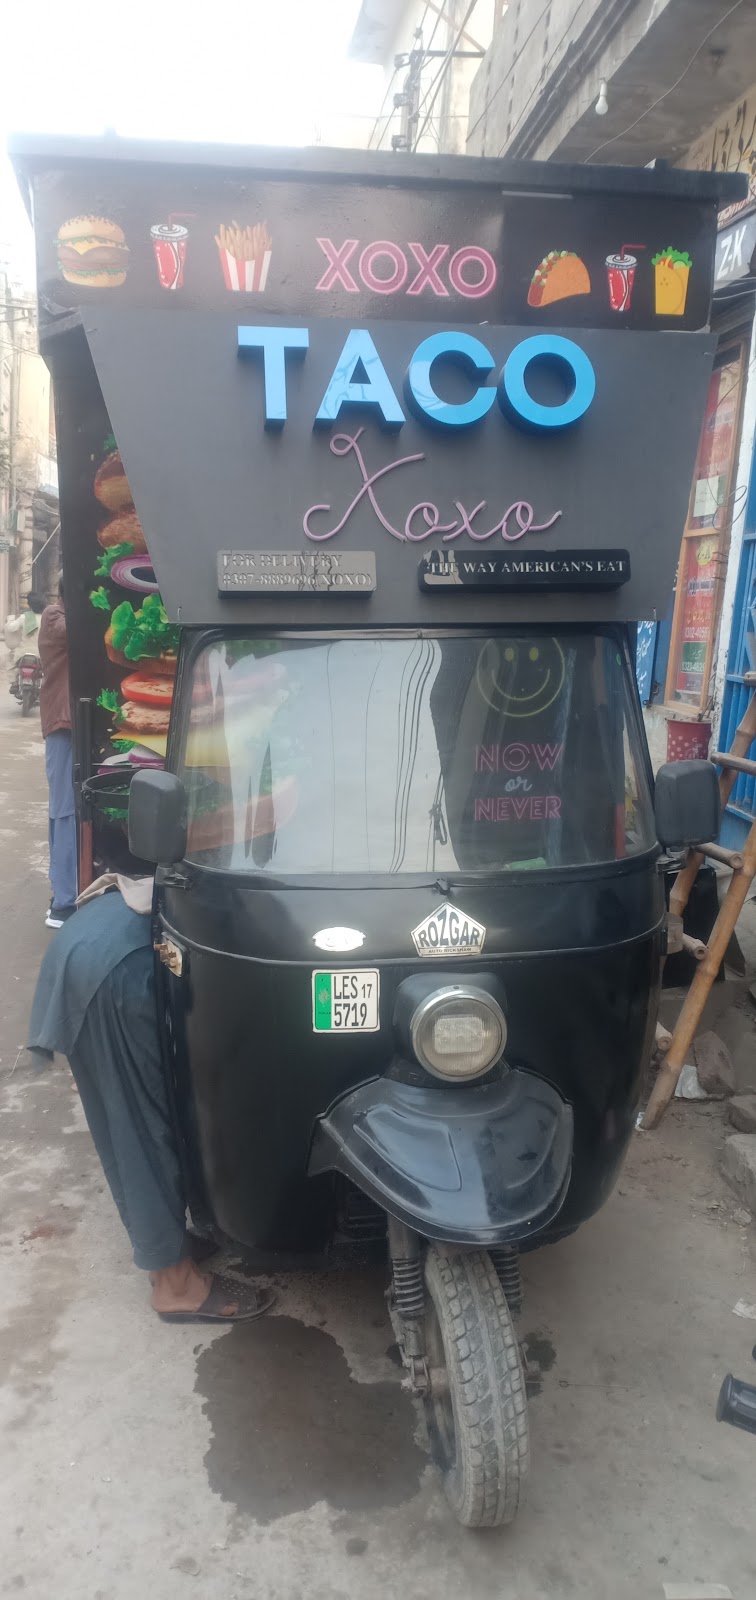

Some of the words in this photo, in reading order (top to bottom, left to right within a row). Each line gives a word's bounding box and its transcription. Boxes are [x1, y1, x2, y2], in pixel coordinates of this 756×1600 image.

[315, 238, 497, 298] XOXO
[236, 325, 596, 432] TACO
[302, 426, 562, 542] Xoxo
[221, 553, 257, 567] FOR
[260, 553, 342, 567] DELIVERY
[427, 562, 459, 573] THE
[463, 562, 498, 573] WAY
[501, 561, 593, 573] AMERICAN'S
[597, 561, 626, 572] EAT
[475, 743, 563, 772] NOW
[504, 776, 533, 792] or
[474, 796, 562, 821] NEVER
[417, 908, 481, 947] ROZGAR
[333, 975, 358, 1000] LES
[361, 983, 373, 999] 17
[334, 1002, 367, 1027] 5719
